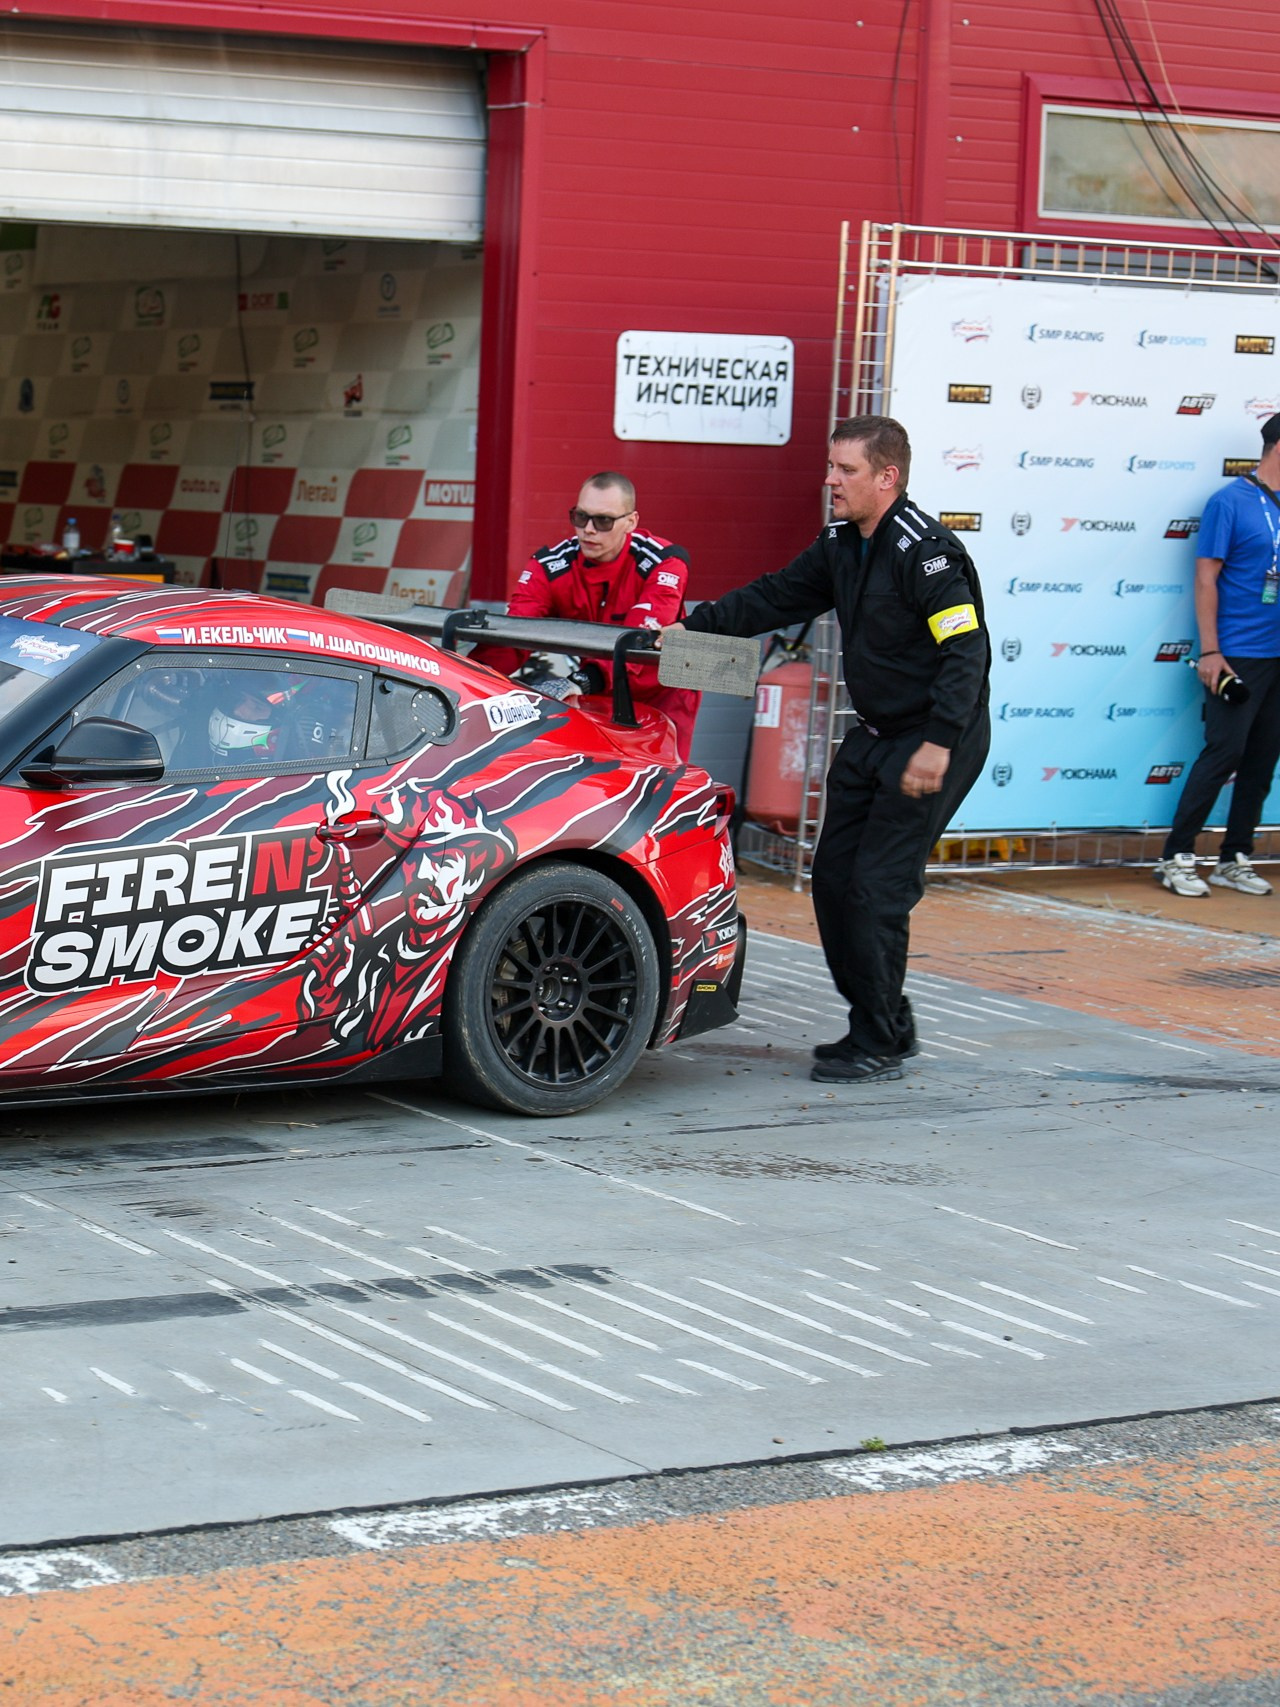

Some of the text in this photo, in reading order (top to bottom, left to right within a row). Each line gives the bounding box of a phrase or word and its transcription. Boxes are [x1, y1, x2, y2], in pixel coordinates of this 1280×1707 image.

[1039, 329, 1104, 342] SMP RACING
[1148, 334, 1207, 347] SMP ESPORTS
[624, 354, 788, 381] ТЕХНИЧЕСКАЯ
[637, 382, 778, 410] ИНСПЕКЦИЯ
[1090, 394, 1148, 407] YOKOHAMA
[1030, 455, 1095, 468] SMP RACING
[1137, 460, 1196, 471] SMP ESPORTS
[1080, 520, 1136, 532] YOKOHAMA
[923, 556, 949, 574] OMP
[657, 573, 680, 588] OMP
[1020, 582, 1083, 593] SMP RACING
[1125, 584, 1144, 594] SMP
[182, 626, 441, 676] И.ЕКЕЛЬЧИК М.ШАПОШНИКОВ
[1070, 645, 1126, 657] YOKOHAMA
[1010, 707, 1074, 718] SMP RACING
[1116, 707, 1137, 717] SMP
[1061, 768, 1117, 780] YOKOHAMA
[44, 845, 239, 923] FIRE
[34, 898, 320, 985] SMOKE
